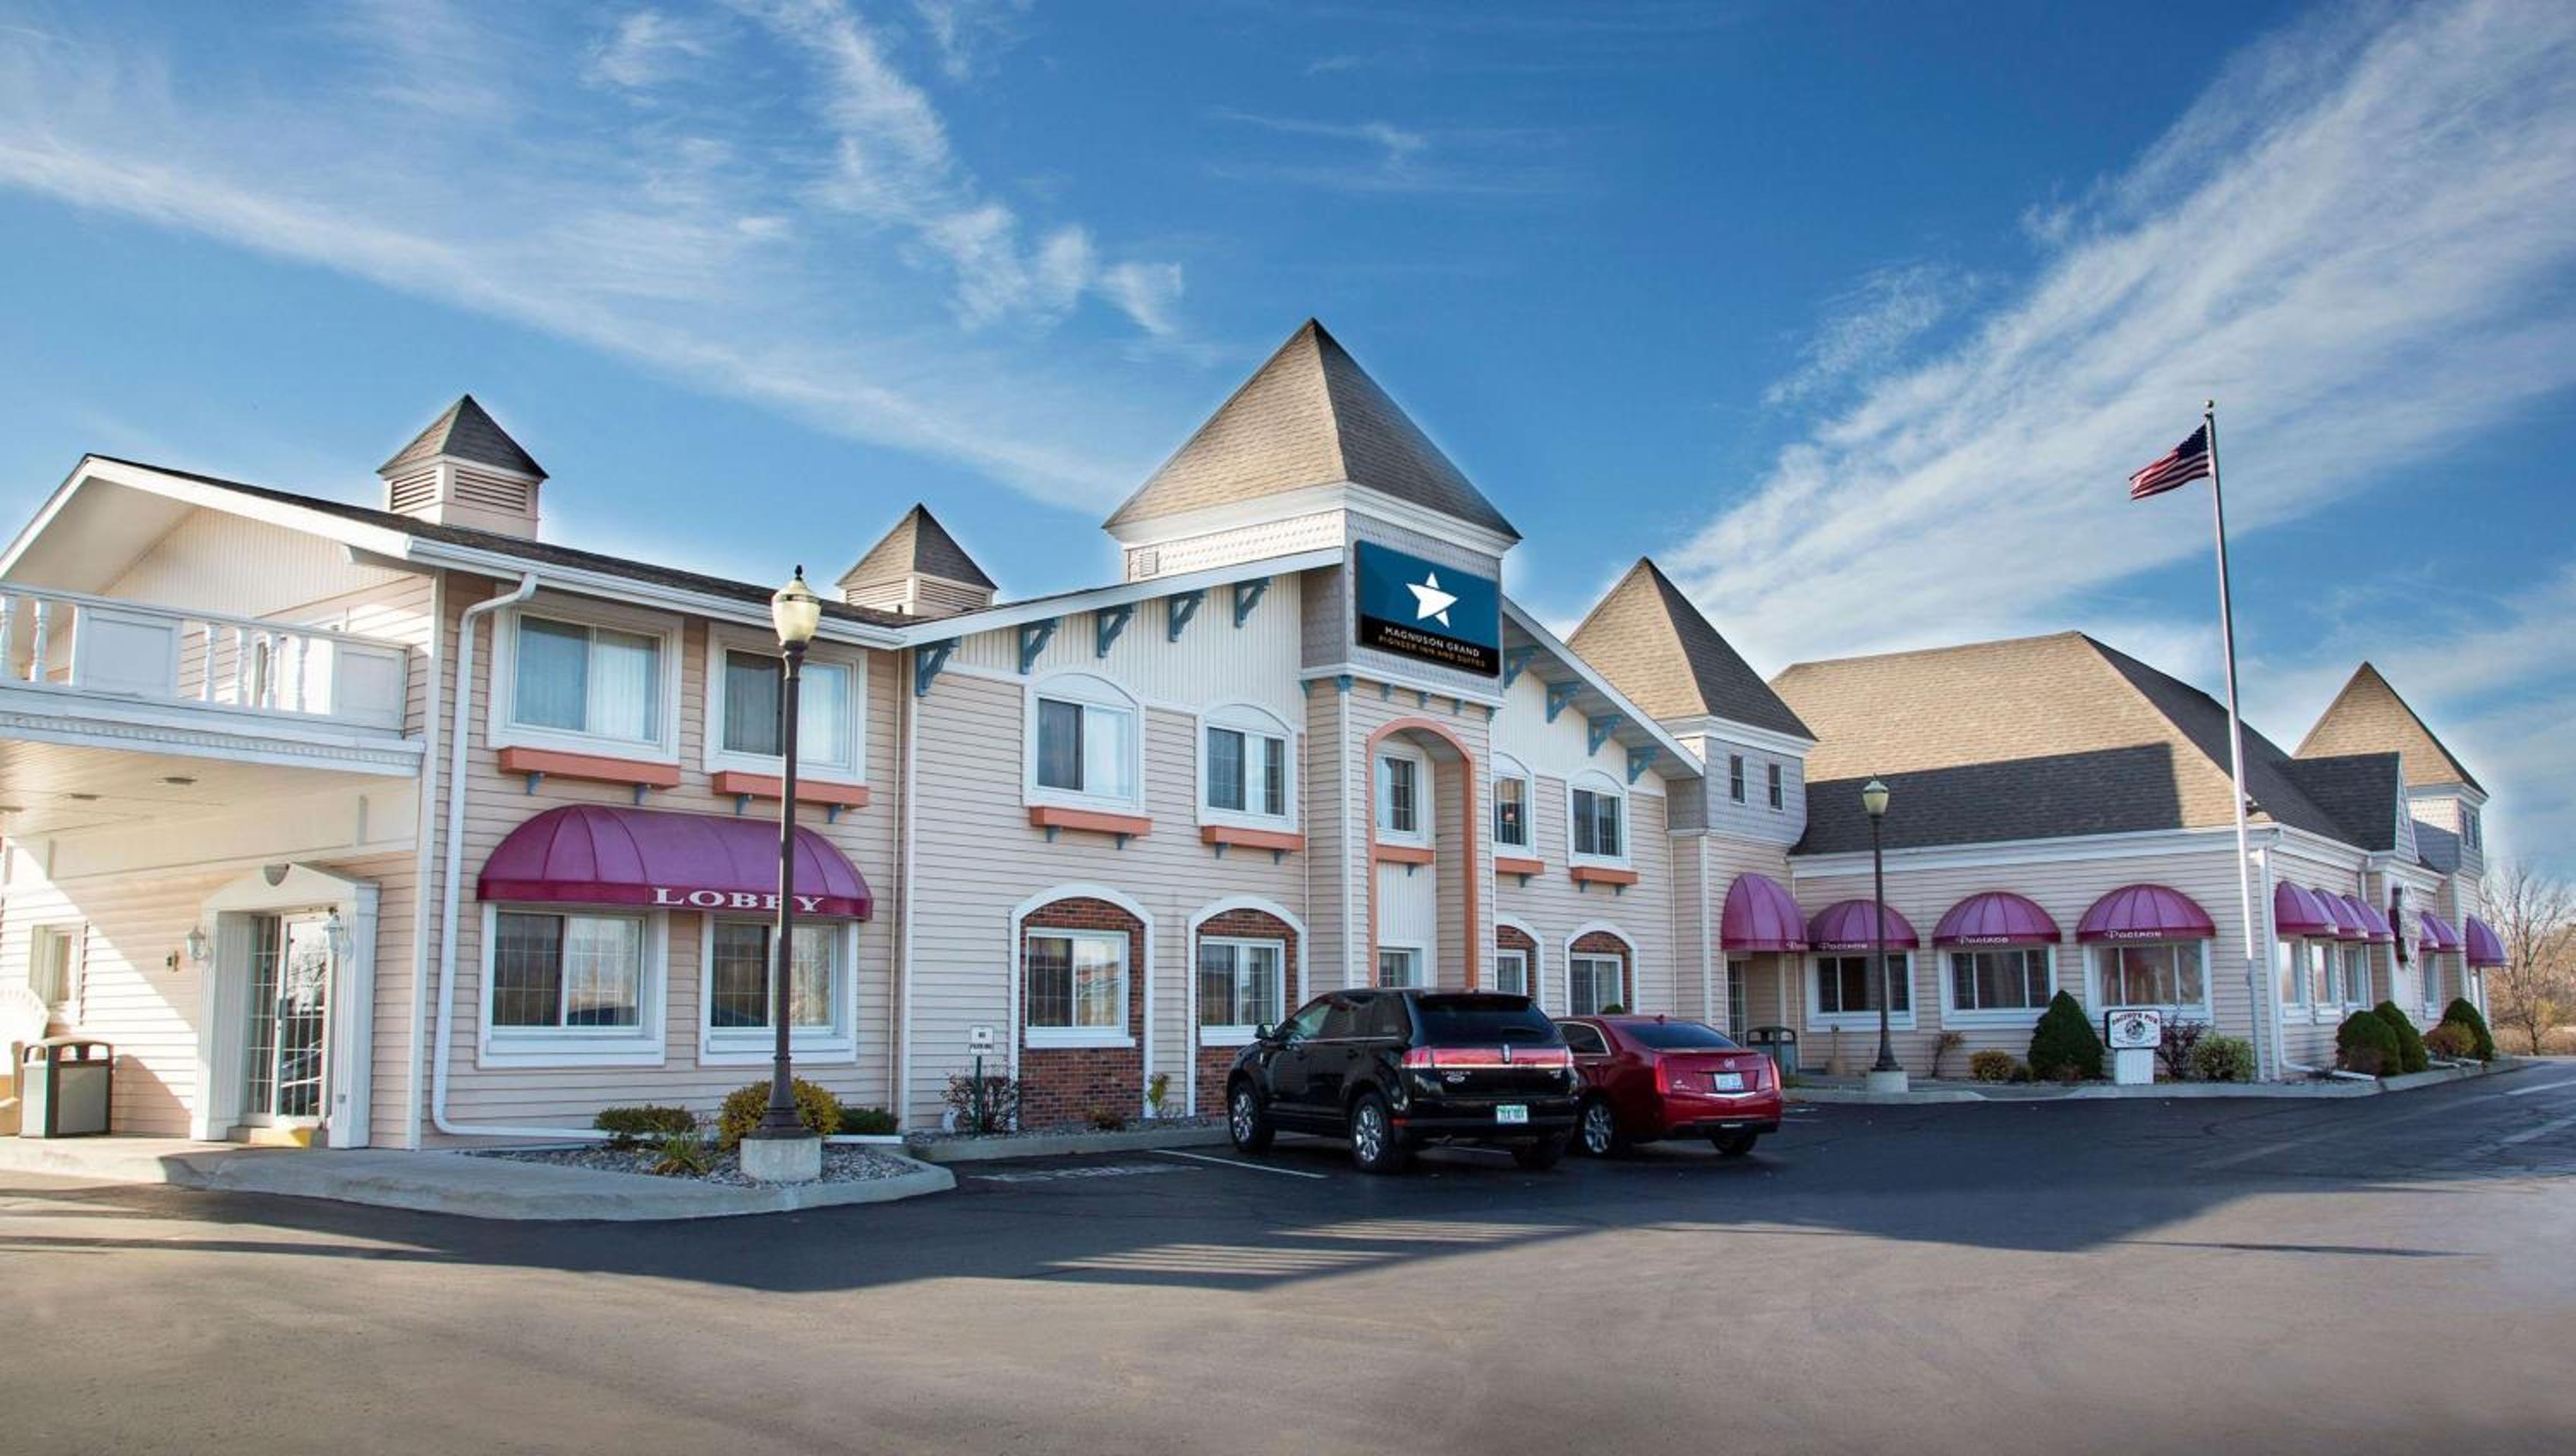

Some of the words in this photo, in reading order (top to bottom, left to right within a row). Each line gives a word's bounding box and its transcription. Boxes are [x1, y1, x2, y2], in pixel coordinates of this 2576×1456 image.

[1378, 634, 1418, 650] PIONEER
[1437, 648, 1455, 660] AND
[1457, 653, 1485, 667] SUITES
[1384, 626, 1443, 647] MAGNUSON
[1446, 641, 1480, 657] GRAND
